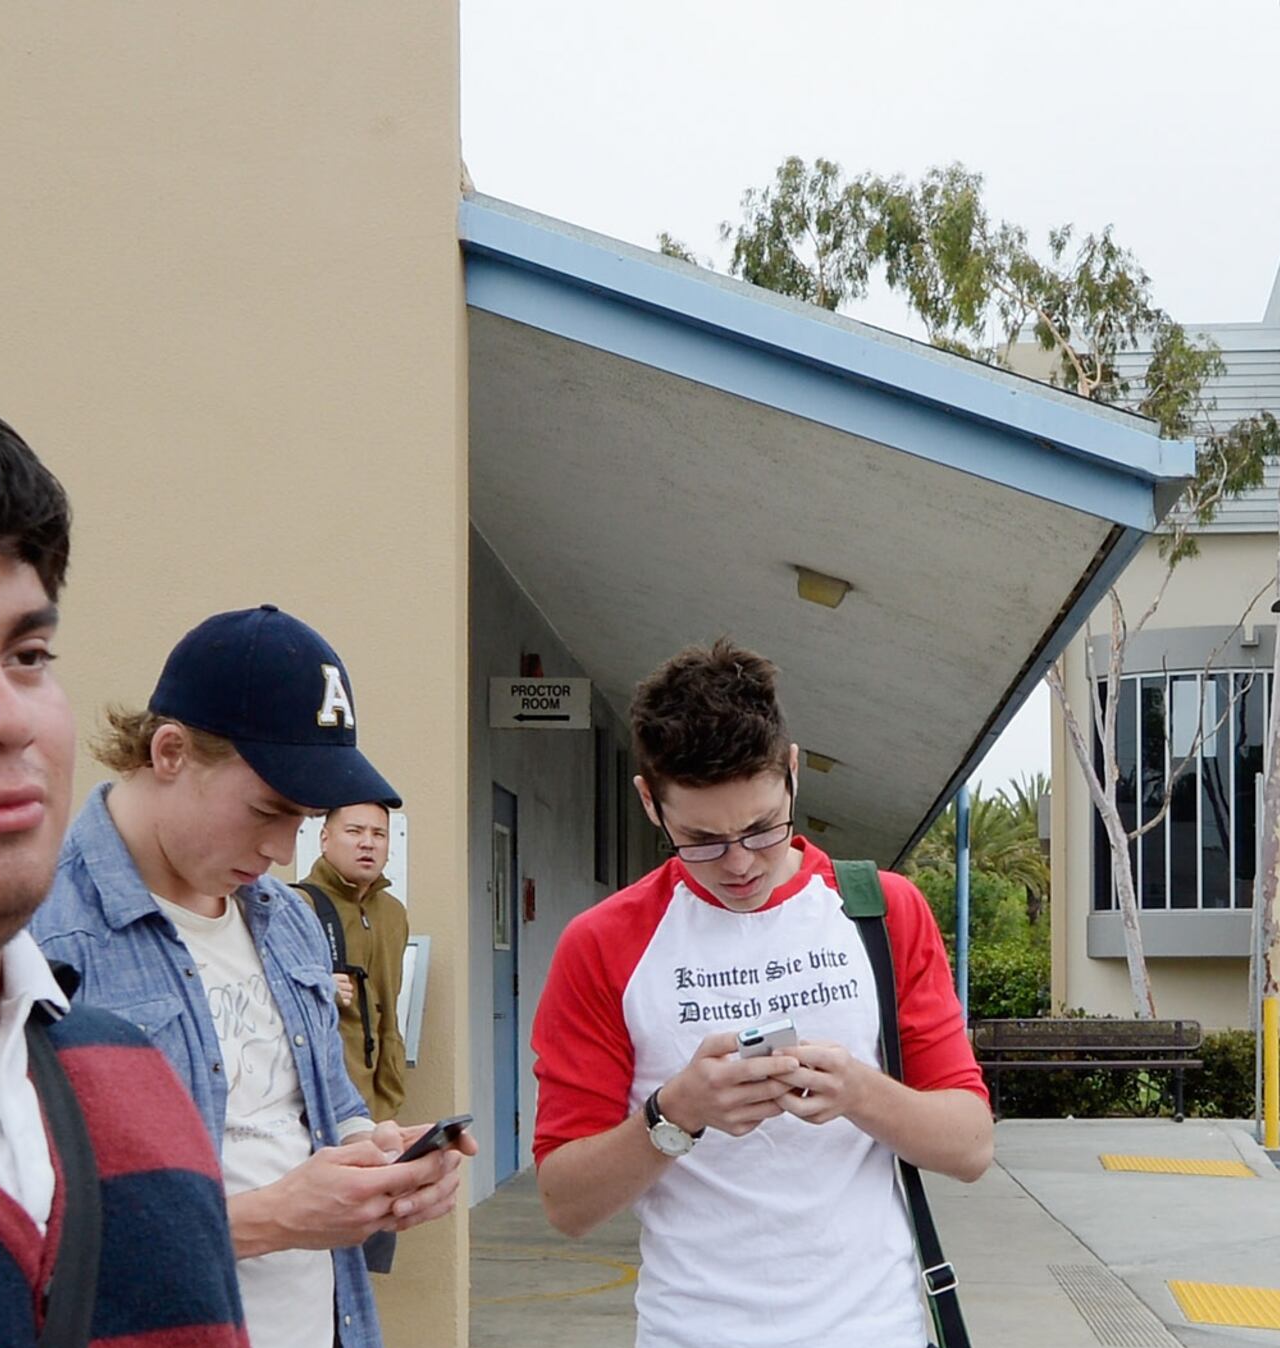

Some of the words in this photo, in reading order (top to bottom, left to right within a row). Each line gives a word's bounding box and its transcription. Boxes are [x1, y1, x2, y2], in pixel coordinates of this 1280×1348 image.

[317, 664, 354, 729] A
[511, 685, 570, 696] PROCTOR
[521, 698, 560, 710] ROOM
[674, 966, 760, 990] Könnten
[765, 957, 802, 981] Sie
[808, 948, 848, 969] bitte
[678, 998, 762, 1024] Deutsch
[768, 979, 858, 1013] sprechen?
